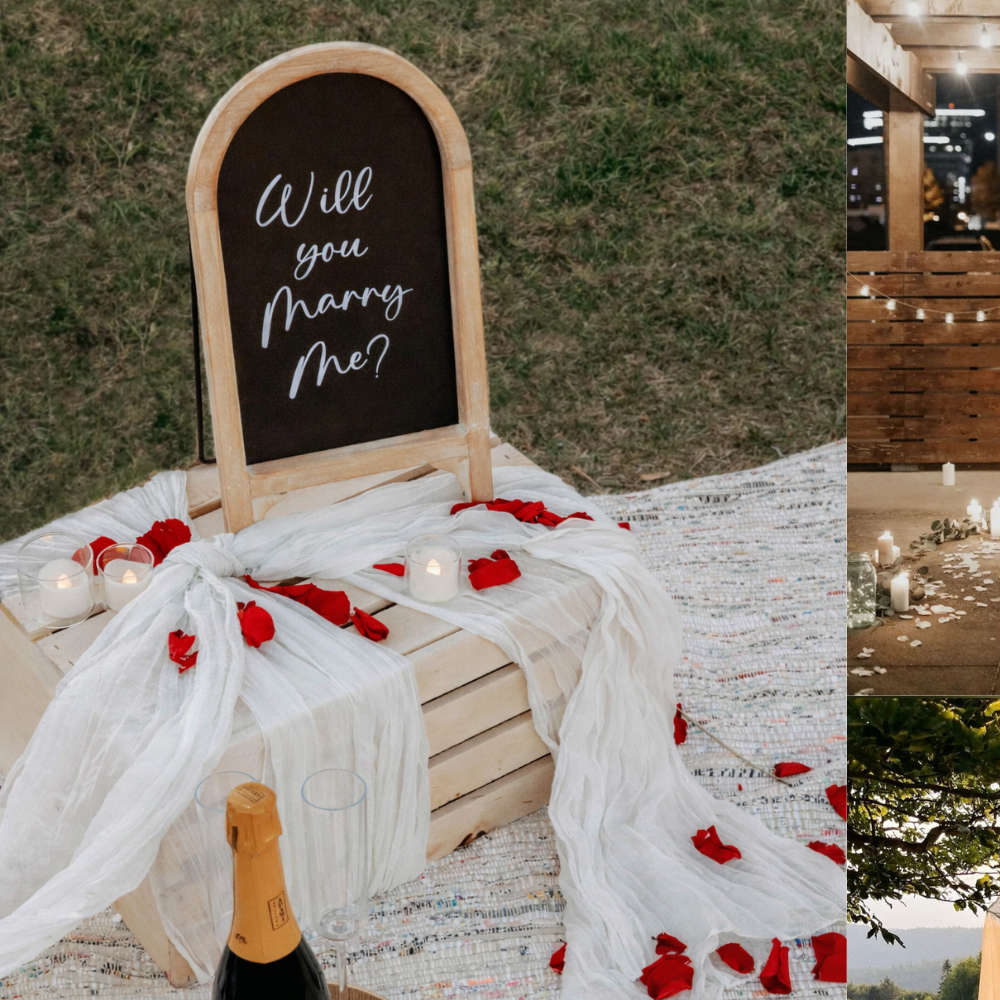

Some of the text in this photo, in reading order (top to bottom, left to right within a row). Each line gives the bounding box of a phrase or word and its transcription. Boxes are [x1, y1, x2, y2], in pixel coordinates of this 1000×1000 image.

[255, 166, 373, 228] Will
[294, 238, 369, 281] you
[261, 285, 414, 349] Marry
[289, 333, 390, 400] Me?
